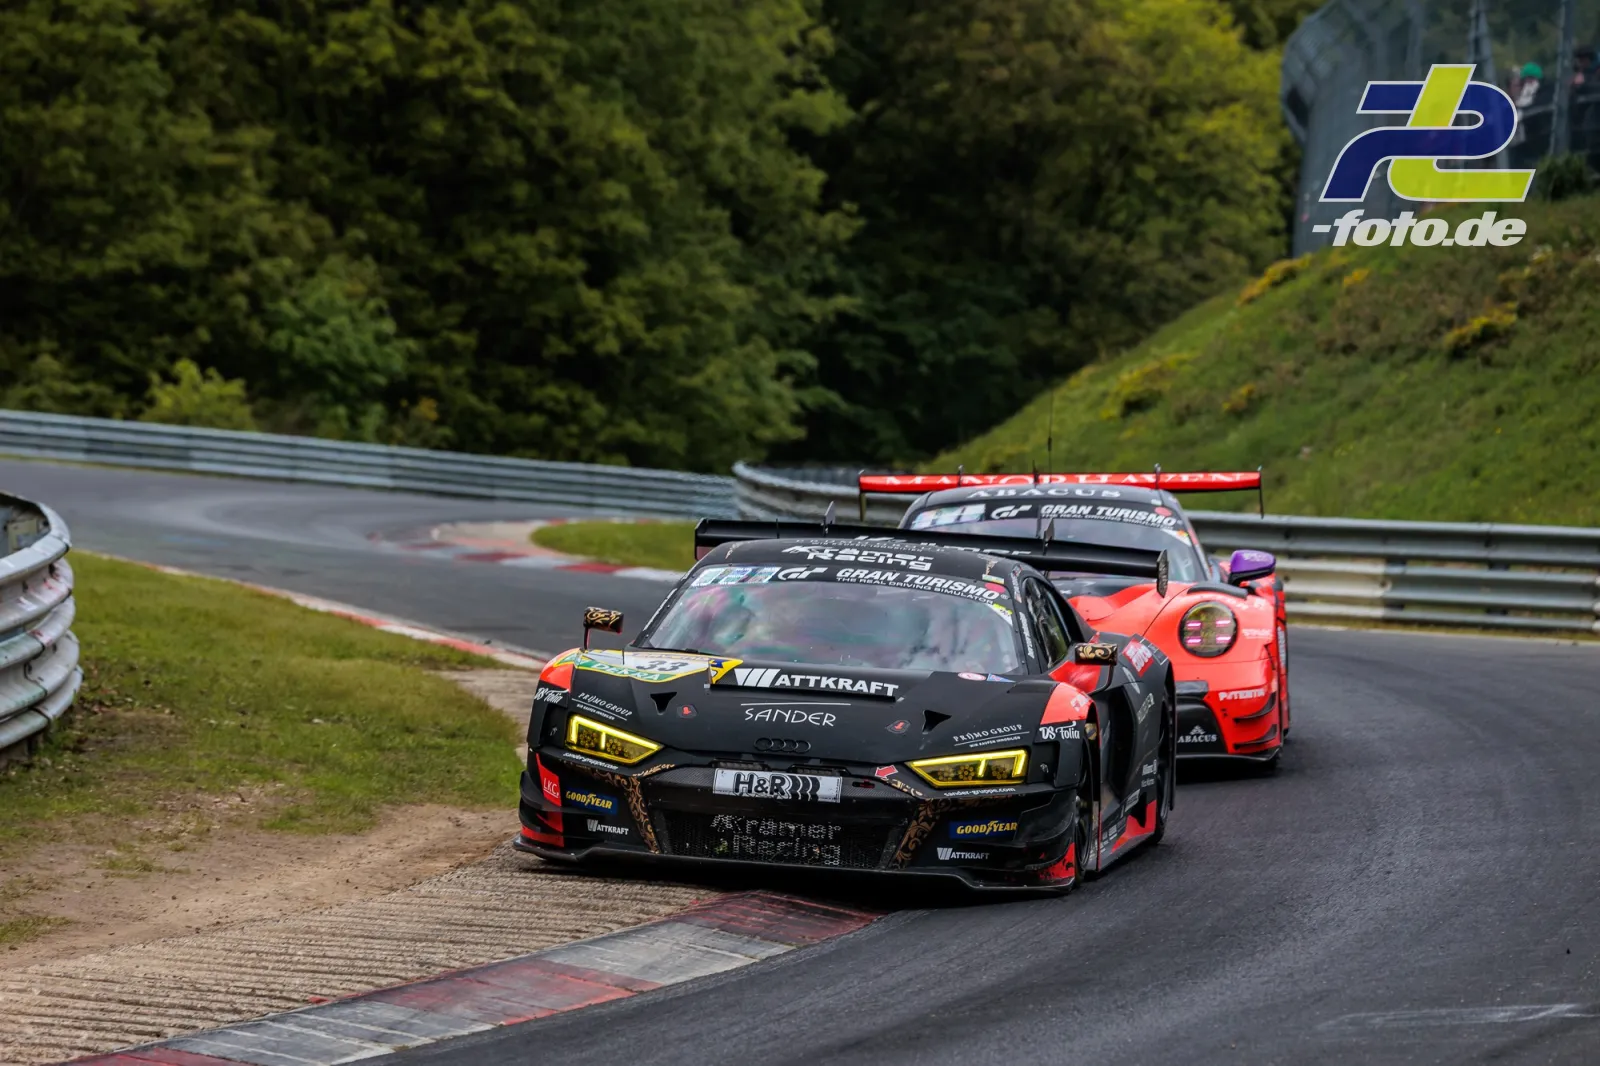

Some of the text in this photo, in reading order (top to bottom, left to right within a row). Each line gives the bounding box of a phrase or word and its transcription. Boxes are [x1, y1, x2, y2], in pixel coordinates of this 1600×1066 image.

[967, 487, 1122, 499] ABACUS
[1041, 504, 1177, 527] GRAN TURISMO
[806, 553, 932, 571] Racing
[836, 567, 900, 582] GRAN
[905, 573, 999, 600] TURISMO
[888, 580, 932, 591] DRIVING
[933, 587, 995, 605] SIMULATOR
[591, 663, 661, 681] DEKRA
[635, 659, 689, 672] 33
[605, 702, 633, 717] GROUP
[744, 707, 837, 727] SANDER
[991, 723, 1023, 736] GROUP
[1039, 720, 1080, 740] DS Folia
[1177, 734, 1217, 743] ABACUS
[733, 772, 790, 799] H&R
[943, 787, 1016, 797] sander-gruppe.com
[565, 790, 613, 810] GOODYEAR
[956, 820, 1018, 835] GOODYEAR
[732, 834, 841, 866] Racing
